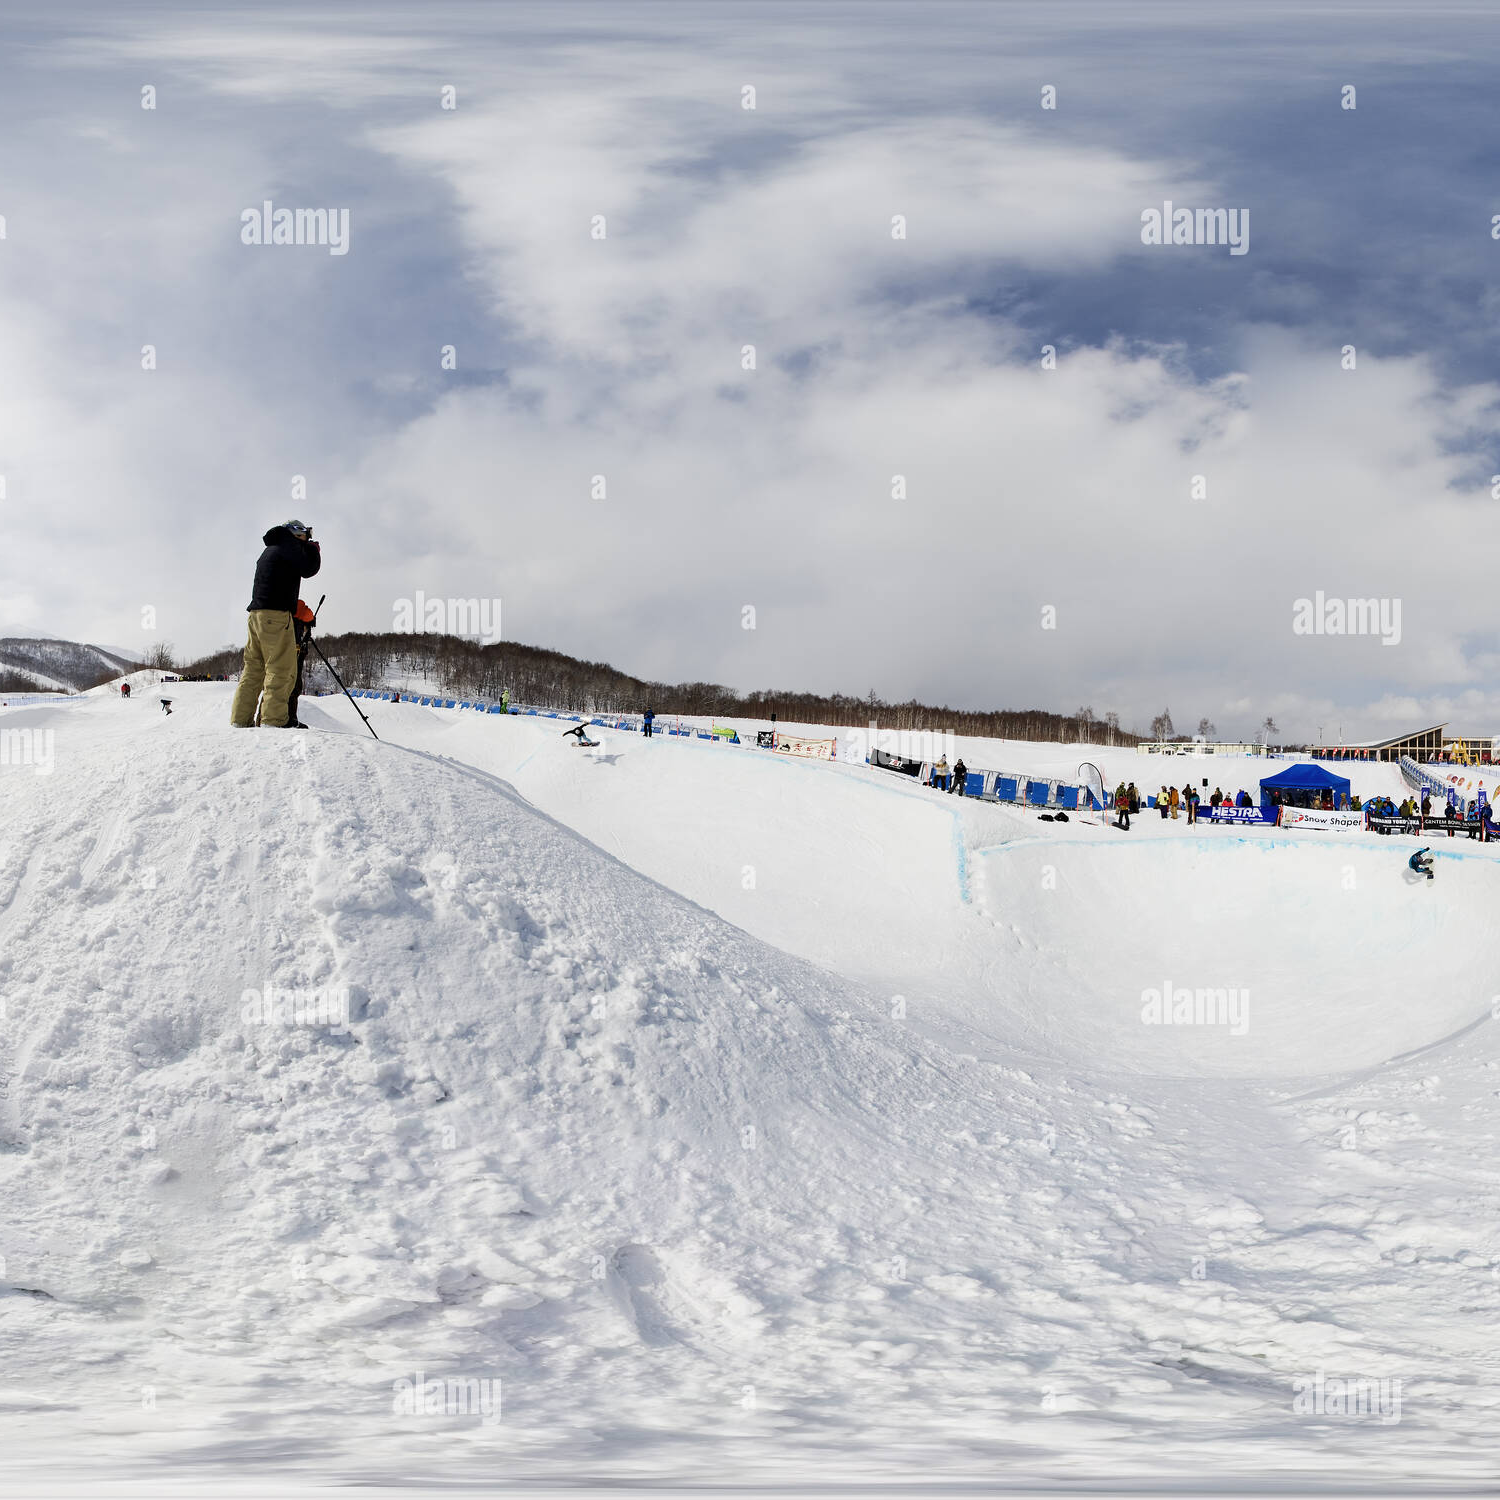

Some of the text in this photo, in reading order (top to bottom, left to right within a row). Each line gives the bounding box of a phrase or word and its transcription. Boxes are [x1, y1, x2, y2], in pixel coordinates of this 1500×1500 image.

[1211, 806, 1263, 818] HESTRA
[1304, 814, 1362, 827] Snow Shaper
